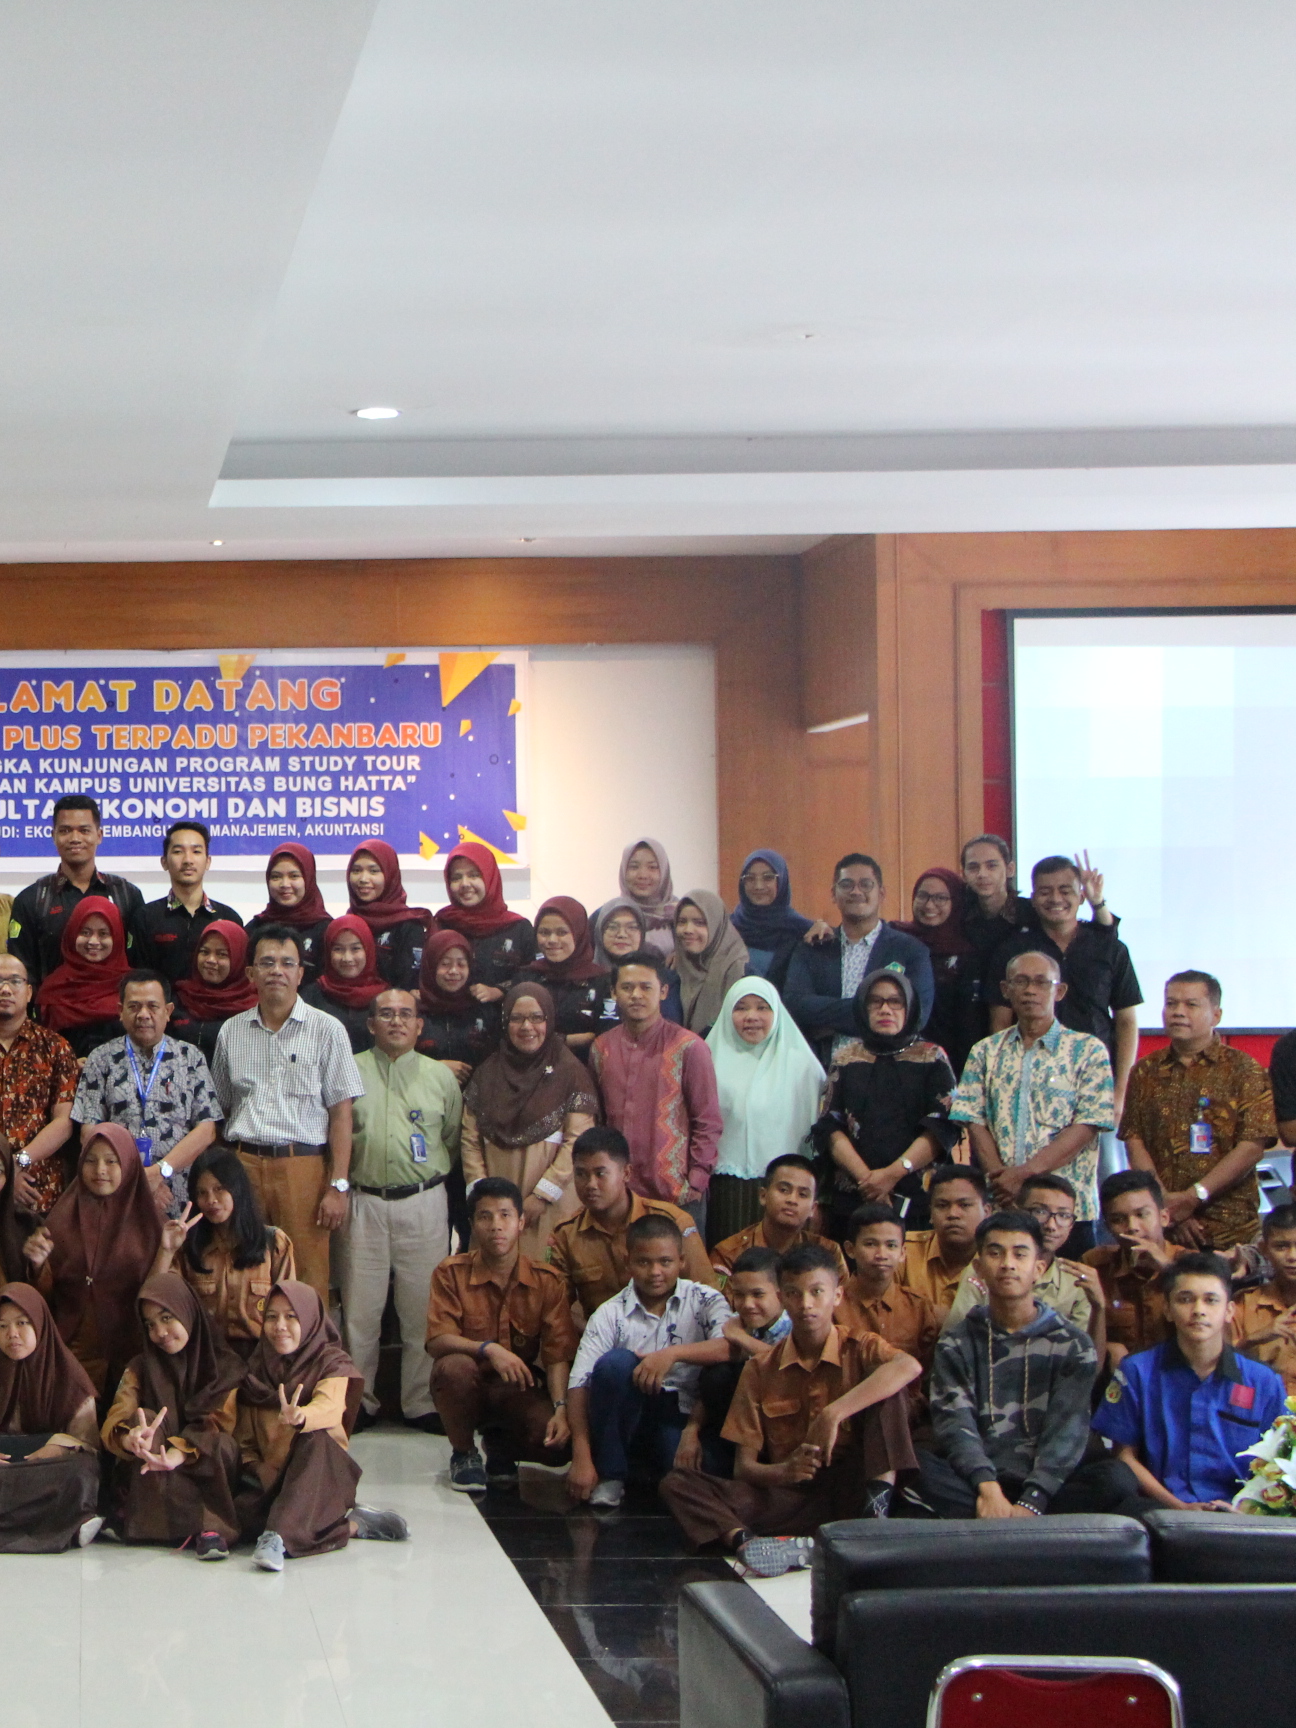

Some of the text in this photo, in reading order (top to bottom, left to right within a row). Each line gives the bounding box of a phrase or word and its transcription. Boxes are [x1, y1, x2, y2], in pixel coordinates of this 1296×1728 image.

[153, 678, 342, 712] DATANG
[3, 725, 81, 750] PLUS
[92, 724, 237, 750] TERPADU
[248, 722, 442, 749] PEKANBARU
[39, 757, 168, 774] KUNJUNGAN
[176, 756, 280, 773] PROGRAM
[288, 755, 357, 772] STUDY
[363, 755, 421, 771] TOUR
[35, 777, 122, 794] KAMPUS
[129, 776, 266, 793] UNIVERSITAS
[273, 776, 332, 792] BUNG
[227, 797, 286, 819] DAN
[296, 796, 385, 818] BISNIS
[209, 824, 301, 838] MANAJEMEN,
[305, 823, 385, 836] AKUNTANSI
